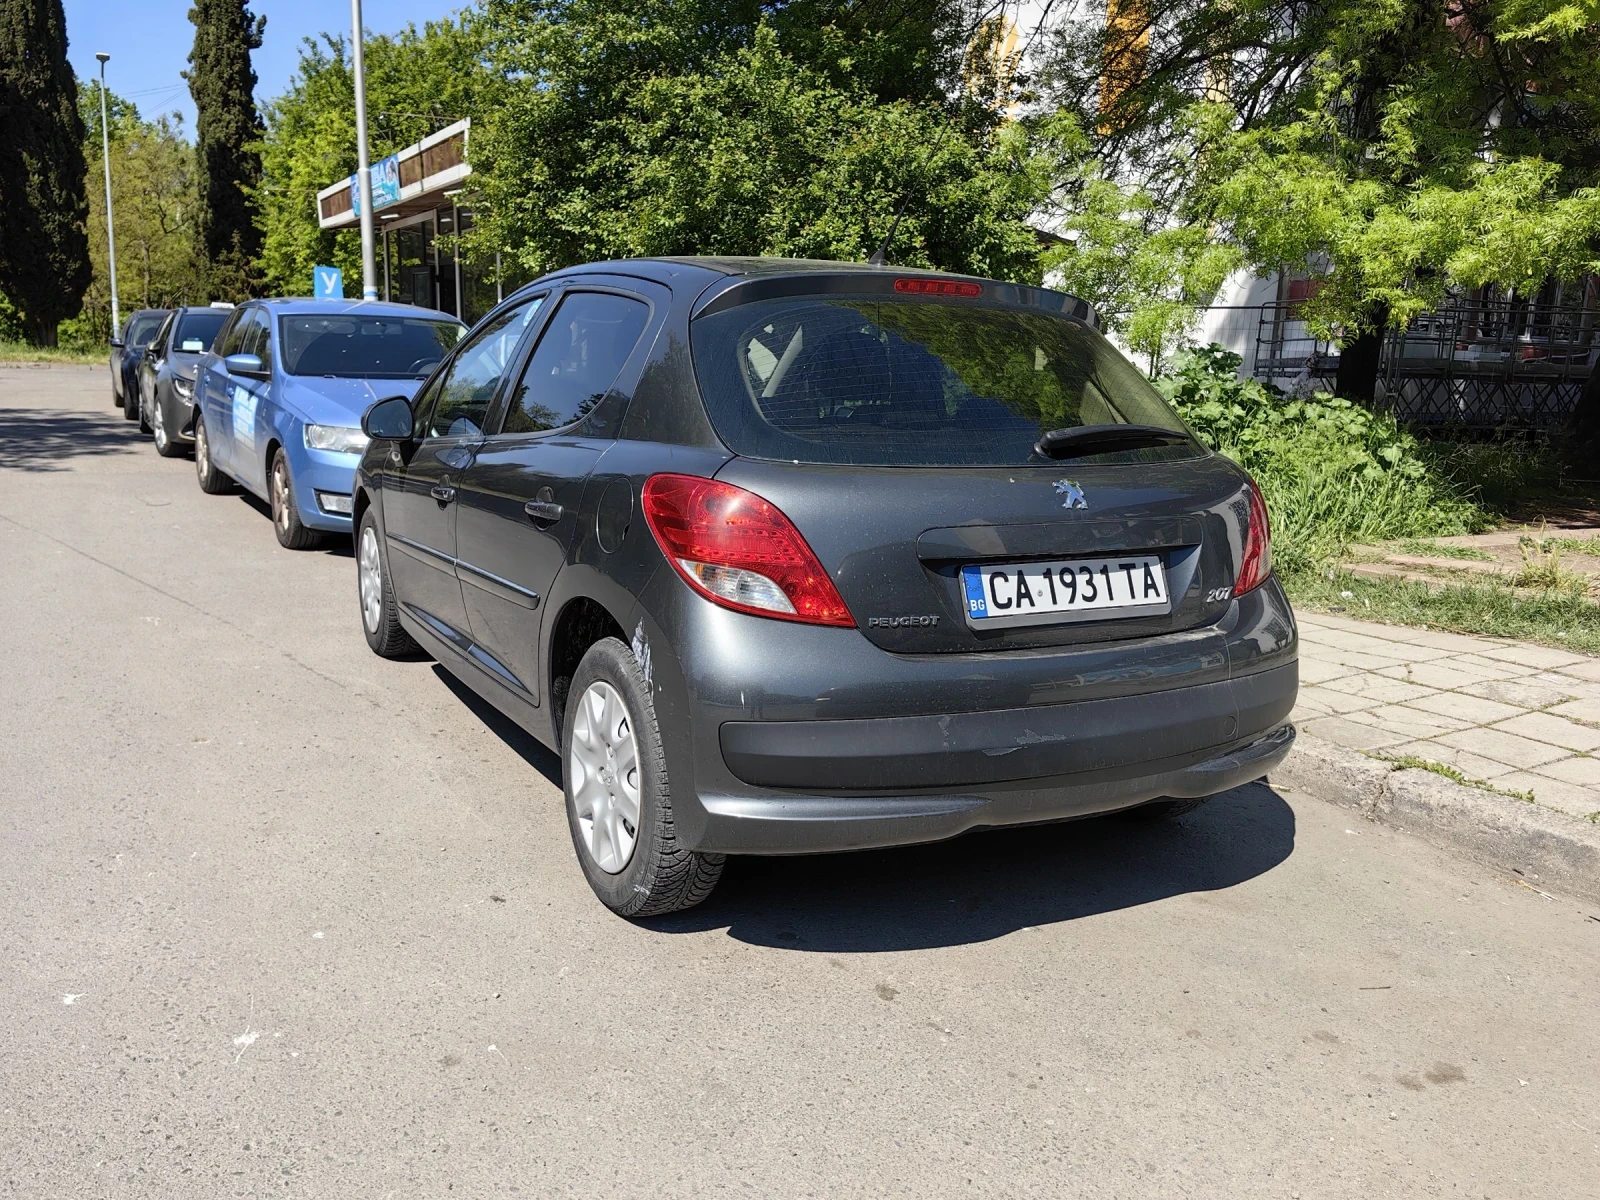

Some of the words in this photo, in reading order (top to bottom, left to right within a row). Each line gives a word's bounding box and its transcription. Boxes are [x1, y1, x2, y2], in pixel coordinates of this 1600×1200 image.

[989, 569, 1036, 610] CA
[1042, 564, 1115, 605] 1931
[1118, 561, 1161, 600] TA
[1206, 585, 1233, 603] 207
[969, 599, 986, 611] BG
[868, 615, 940, 628] PEUGEOT
